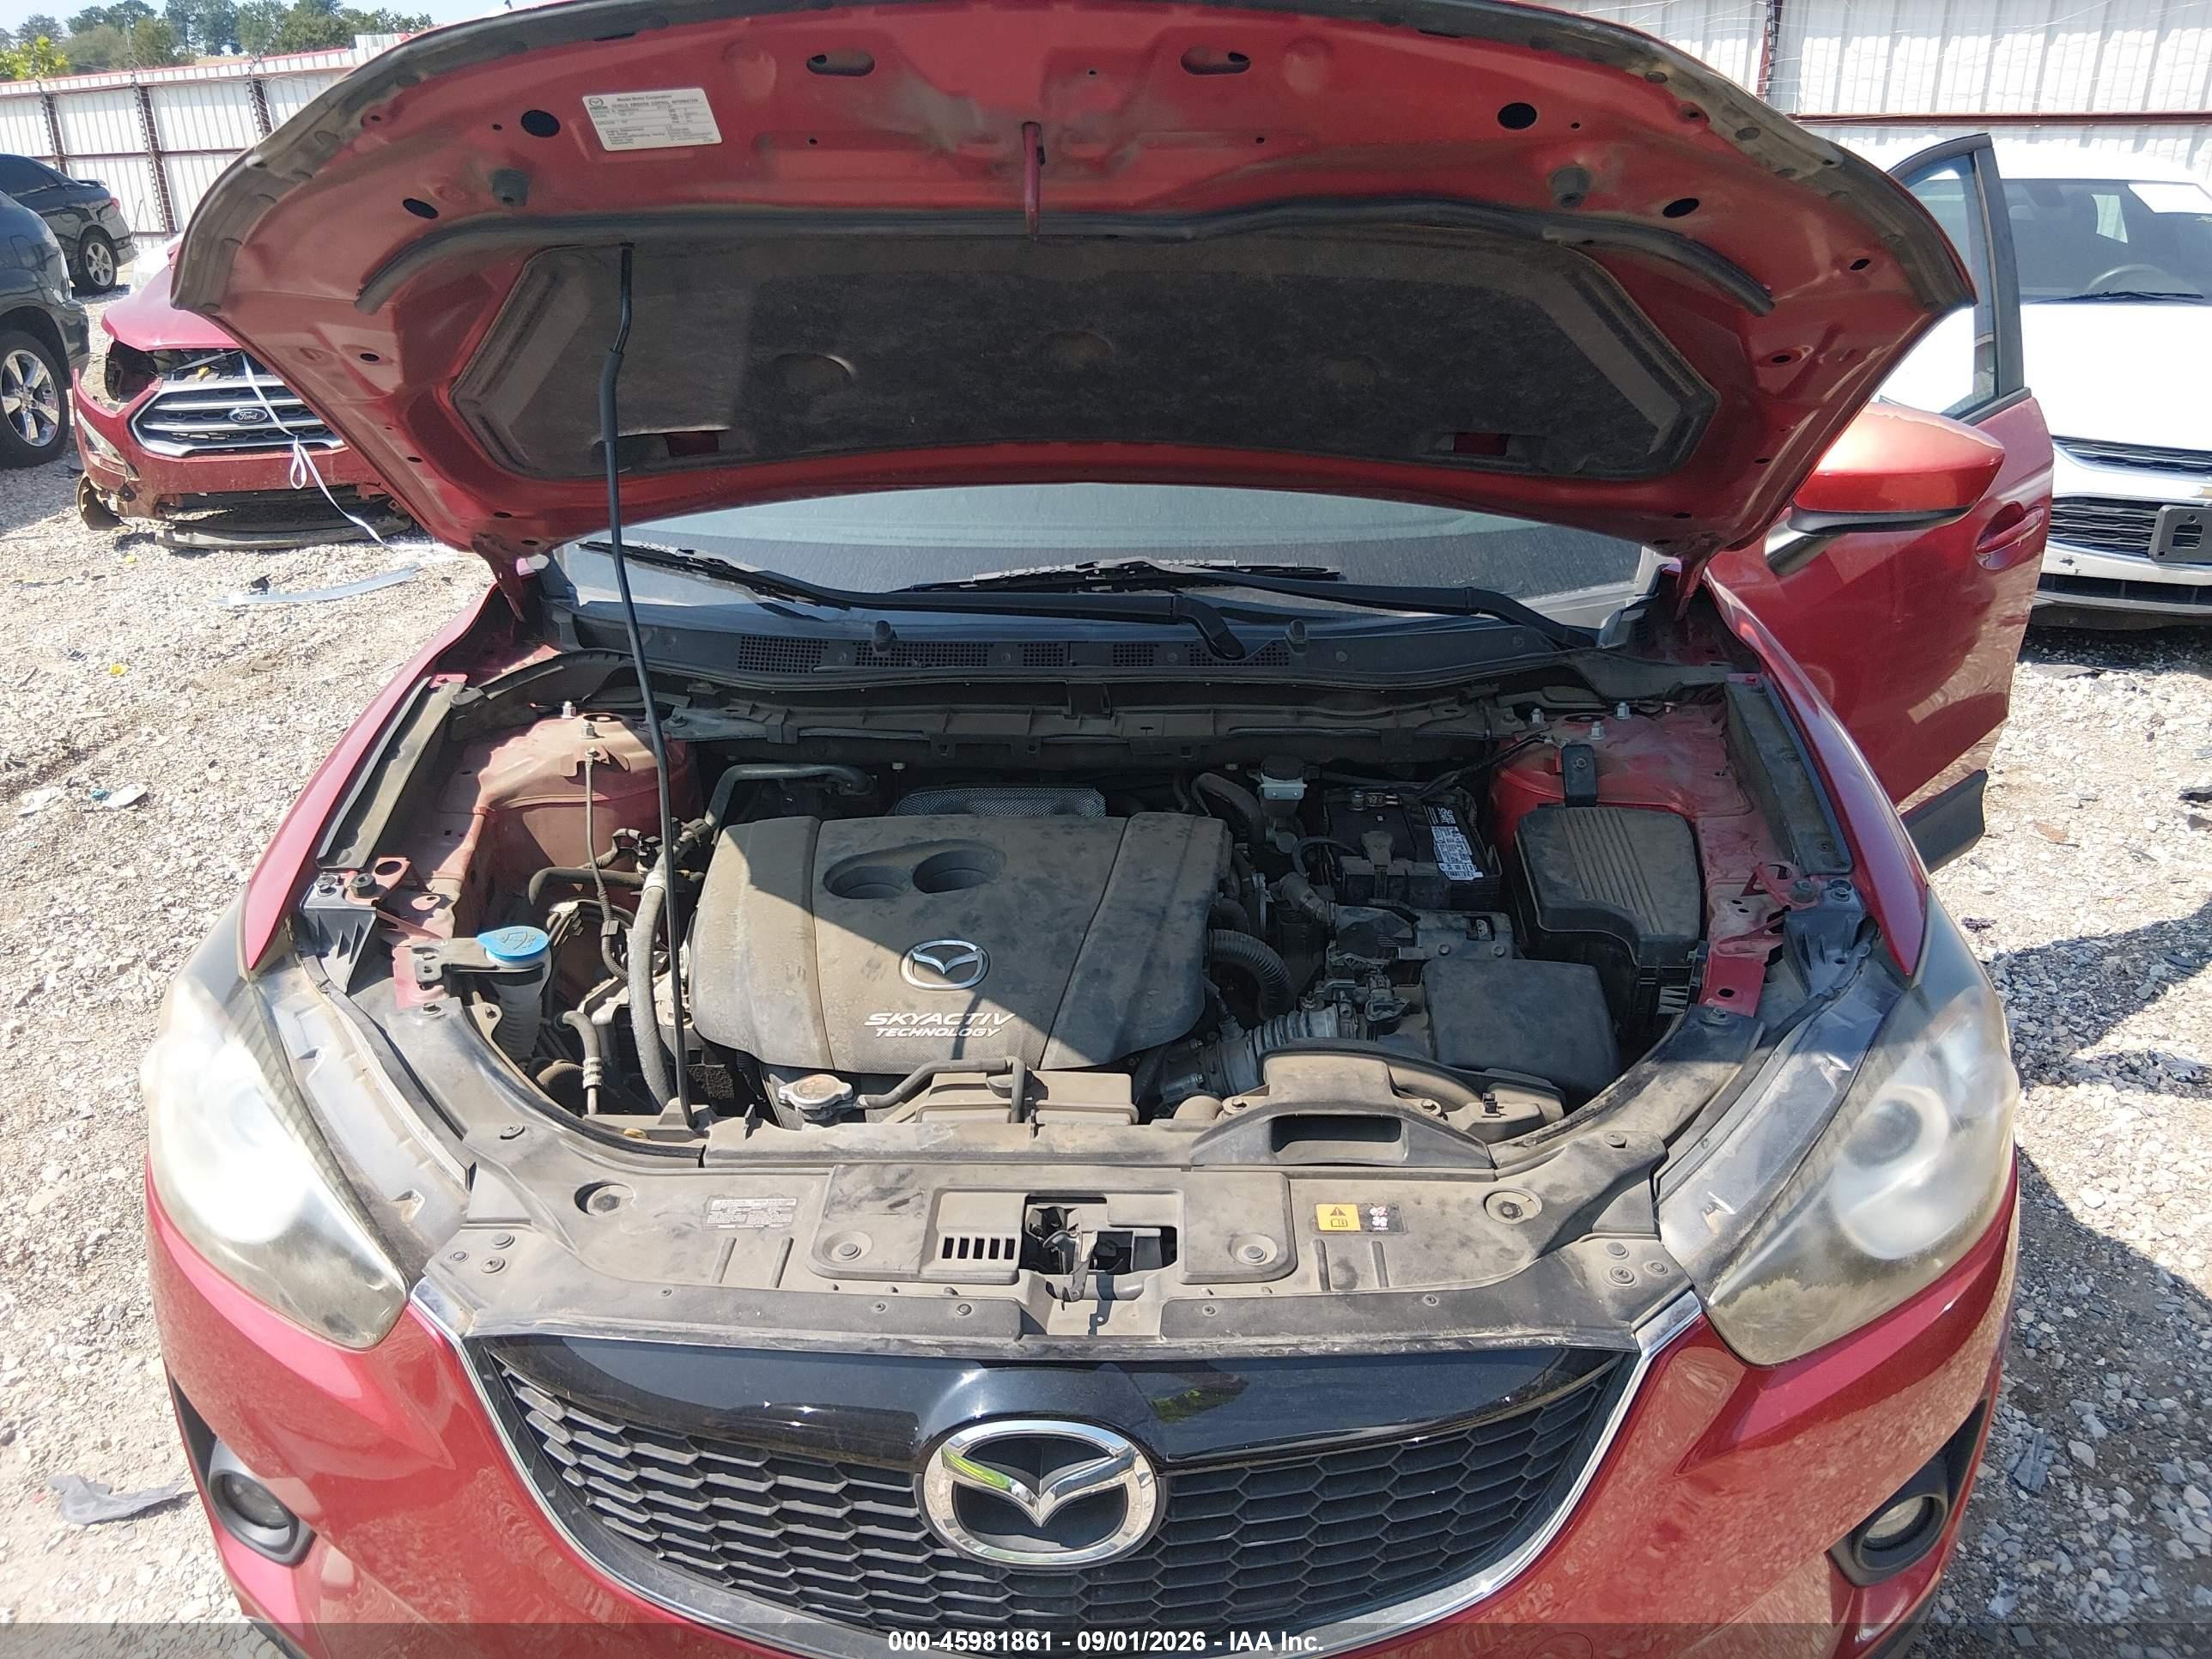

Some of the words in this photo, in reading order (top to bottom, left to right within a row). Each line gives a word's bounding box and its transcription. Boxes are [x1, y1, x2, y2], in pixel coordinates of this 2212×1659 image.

[238, 411, 258, 421] Ford
[864, 1012, 1017, 1027] SKYACTIV
[875, 1028, 1003, 1038] TECHNOLOGY
